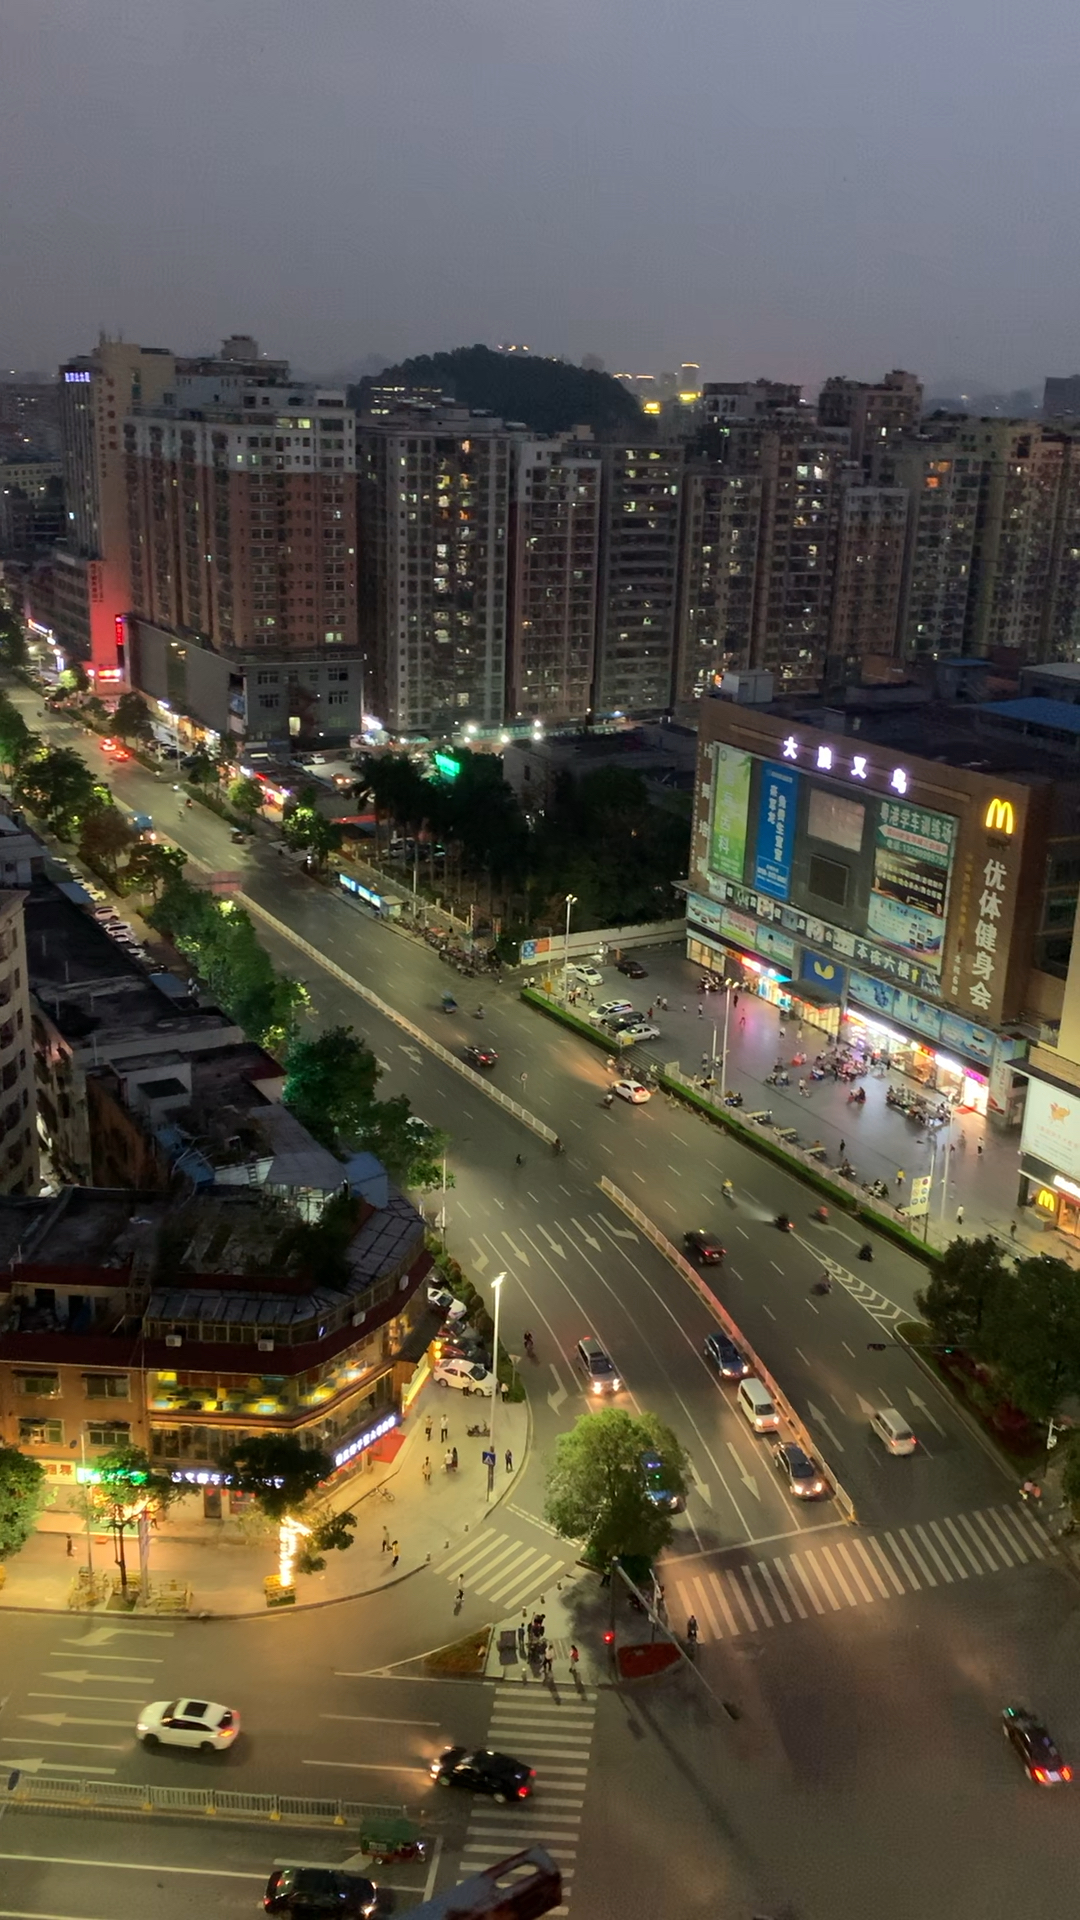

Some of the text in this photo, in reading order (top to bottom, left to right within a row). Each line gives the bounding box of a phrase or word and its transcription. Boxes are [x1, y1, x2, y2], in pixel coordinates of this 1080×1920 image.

[969, 858, 1008, 1010] 优体健身会
